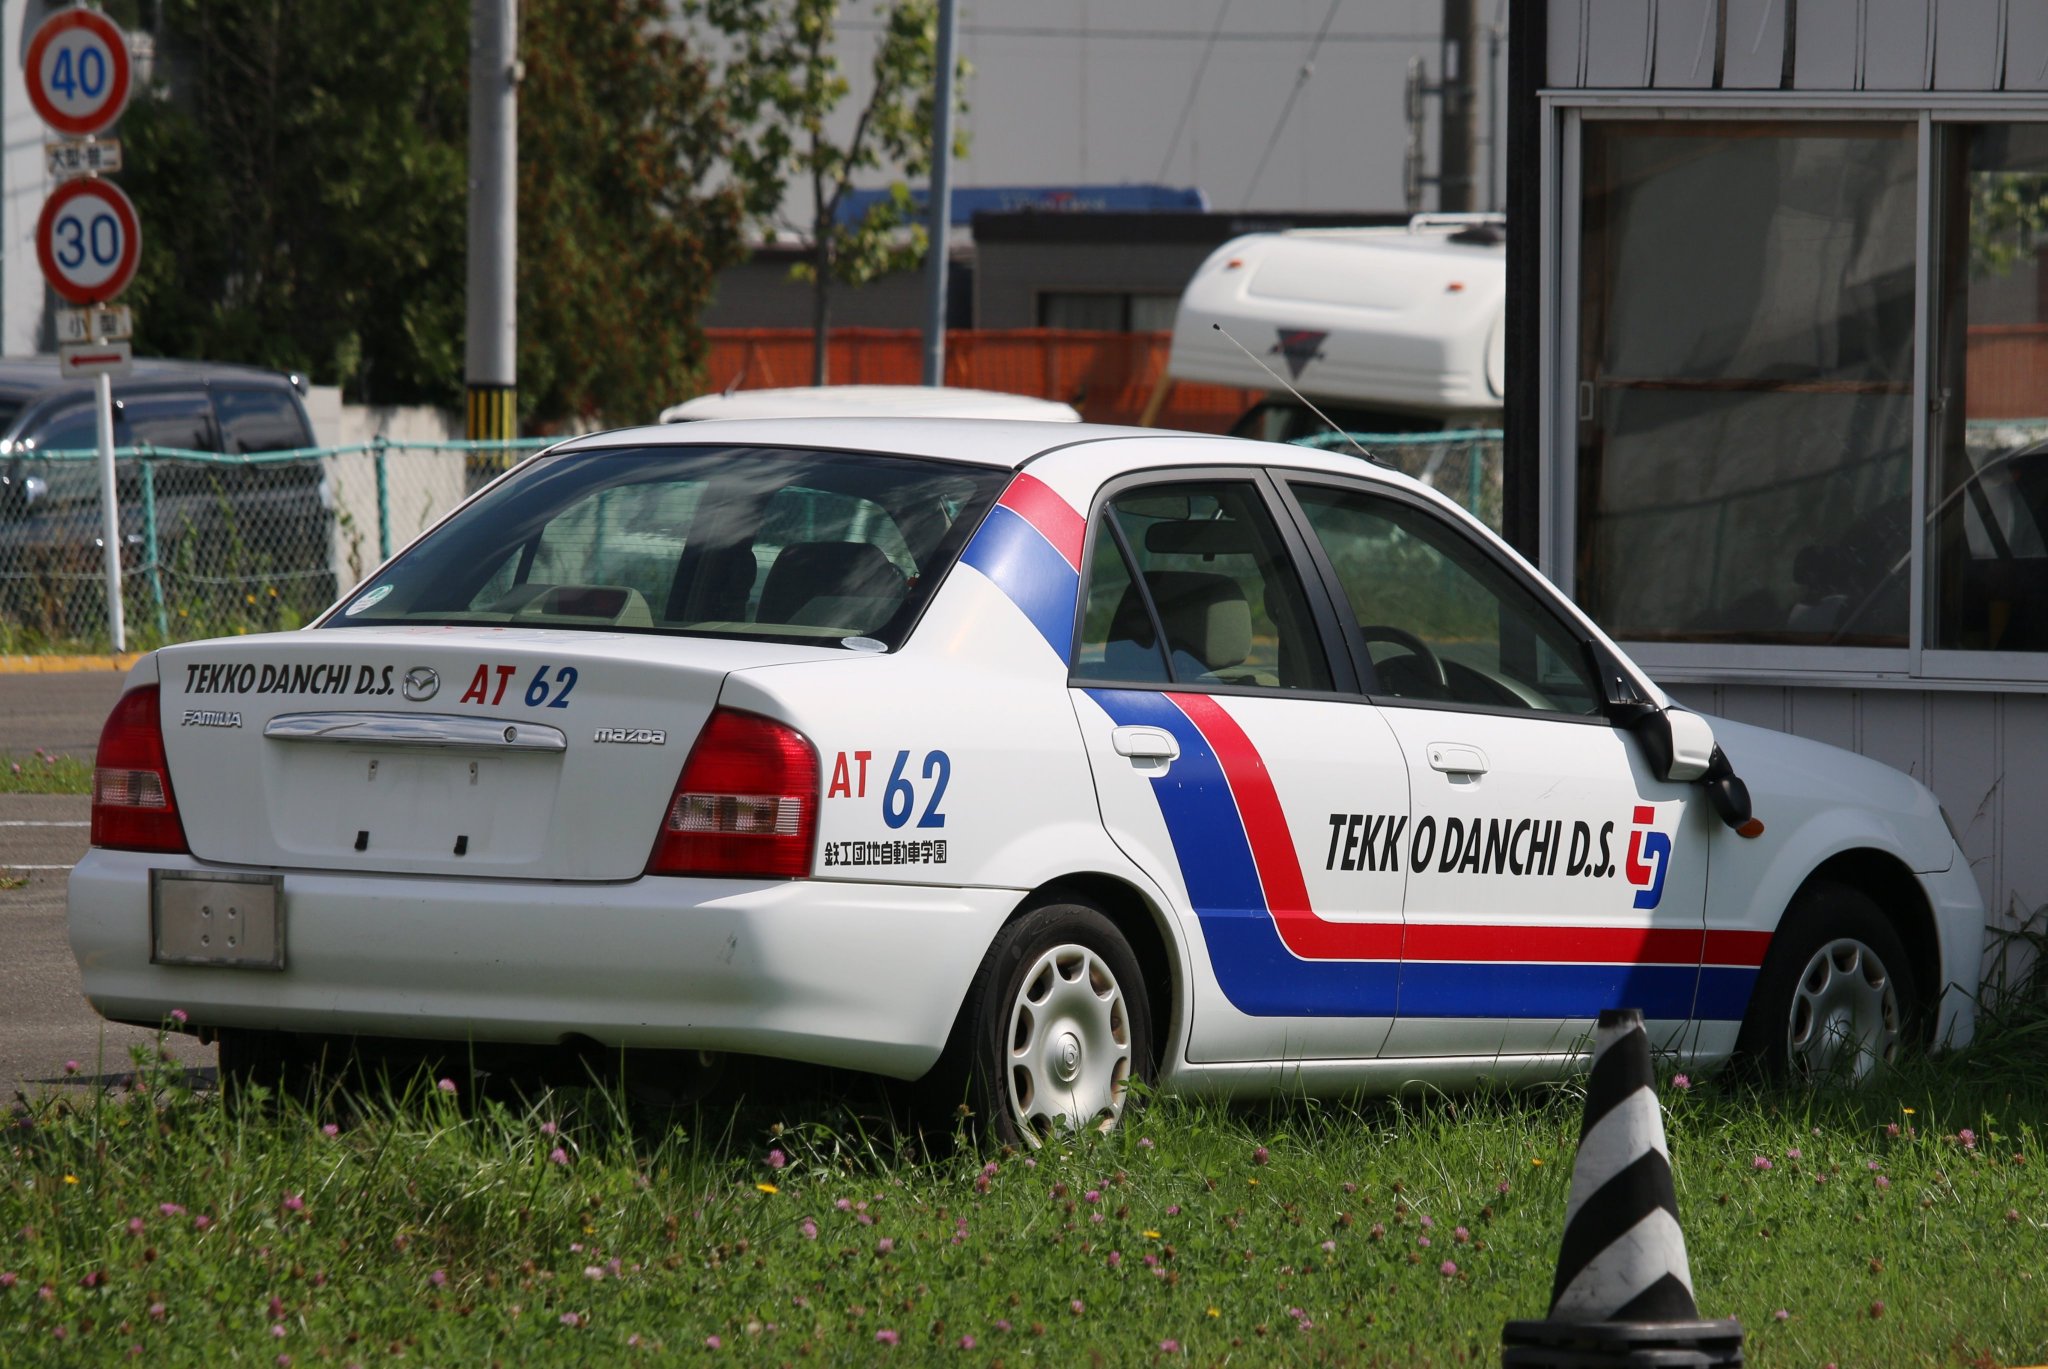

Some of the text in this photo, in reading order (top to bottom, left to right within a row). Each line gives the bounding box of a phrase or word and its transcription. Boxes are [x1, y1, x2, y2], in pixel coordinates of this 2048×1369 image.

[51, 46, 106, 100] 40
[56, 214, 120, 269] 30
[184, 663, 578, 708] TEKKO DANCHI D.S. AT 62
[181, 710, 242, 728] FAMILIA
[827, 749, 951, 829] AT 62
[824, 839, 947, 866] 鉄工団地自動車学園
[1438, 817, 1562, 876] DANCHI
[1566, 820, 1616, 878] D.S.
